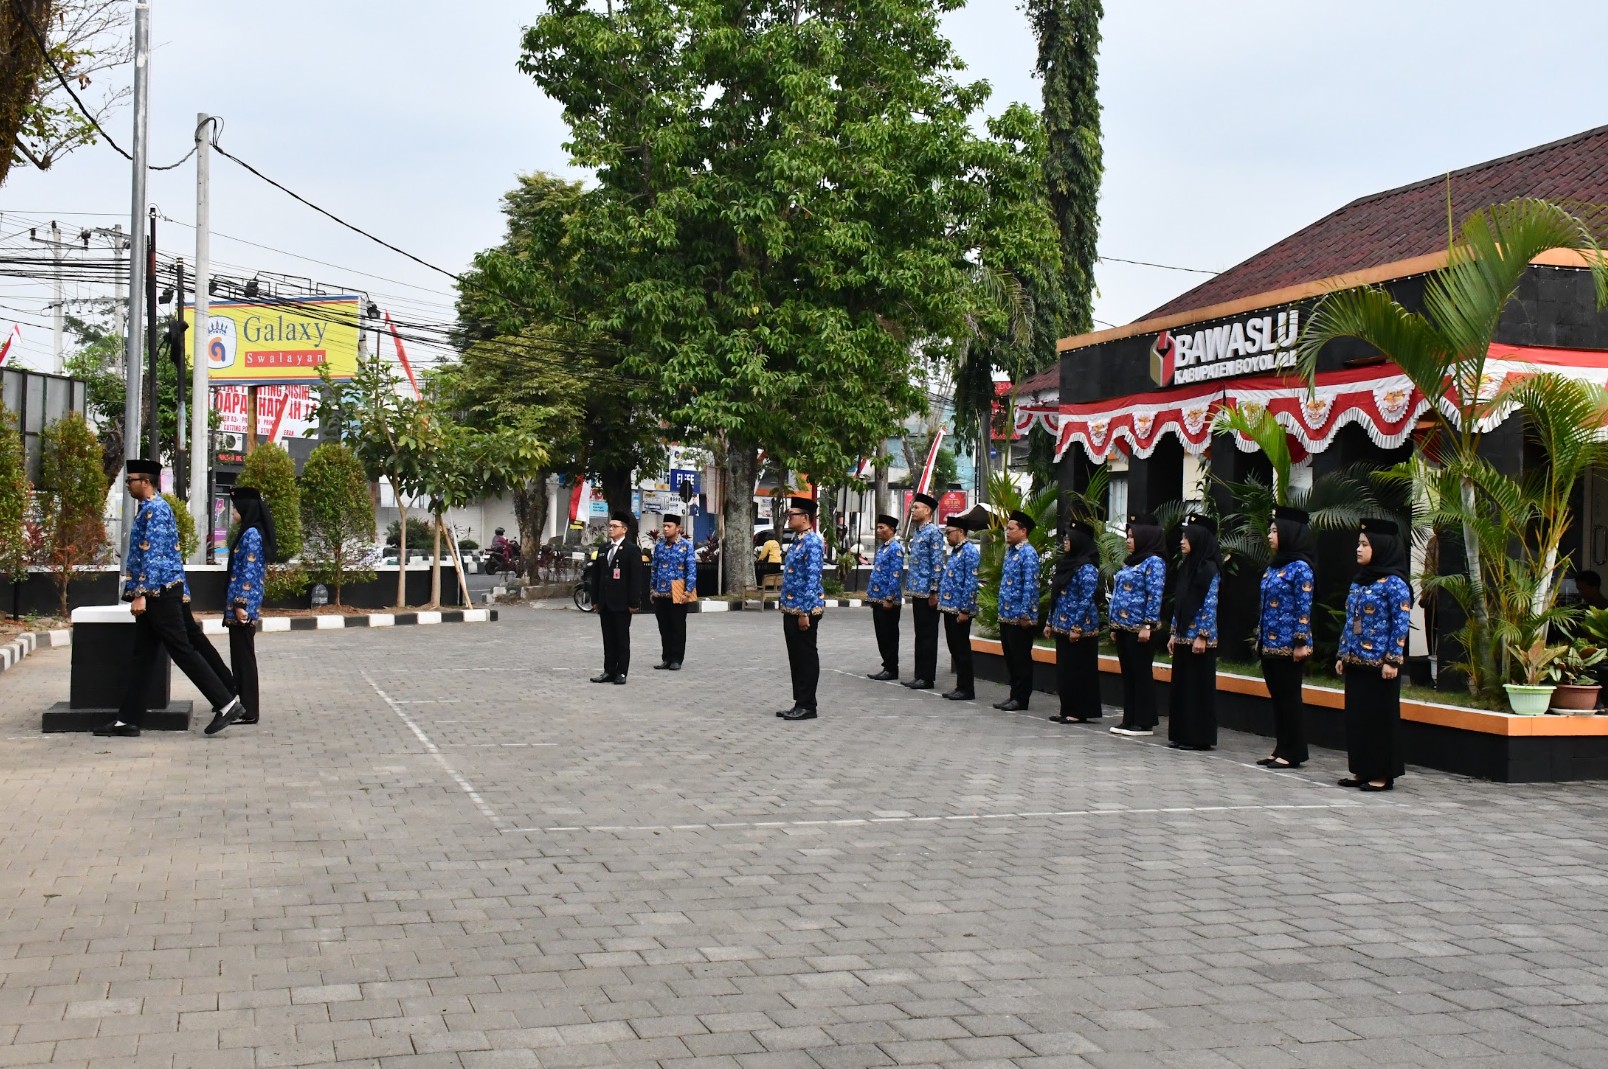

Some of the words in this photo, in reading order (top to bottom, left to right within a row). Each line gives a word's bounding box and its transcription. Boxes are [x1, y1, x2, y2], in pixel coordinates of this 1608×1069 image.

[244, 315, 327, 348] Galaxy
[1175, 309, 1299, 368] BAWASLU
[247, 352, 323, 365] Swalayan
[1174, 360, 1236, 385] KABUPATEN
[1235, 350, 1297, 375] BOYOLALI
[258, 397, 301, 420] HADAH
